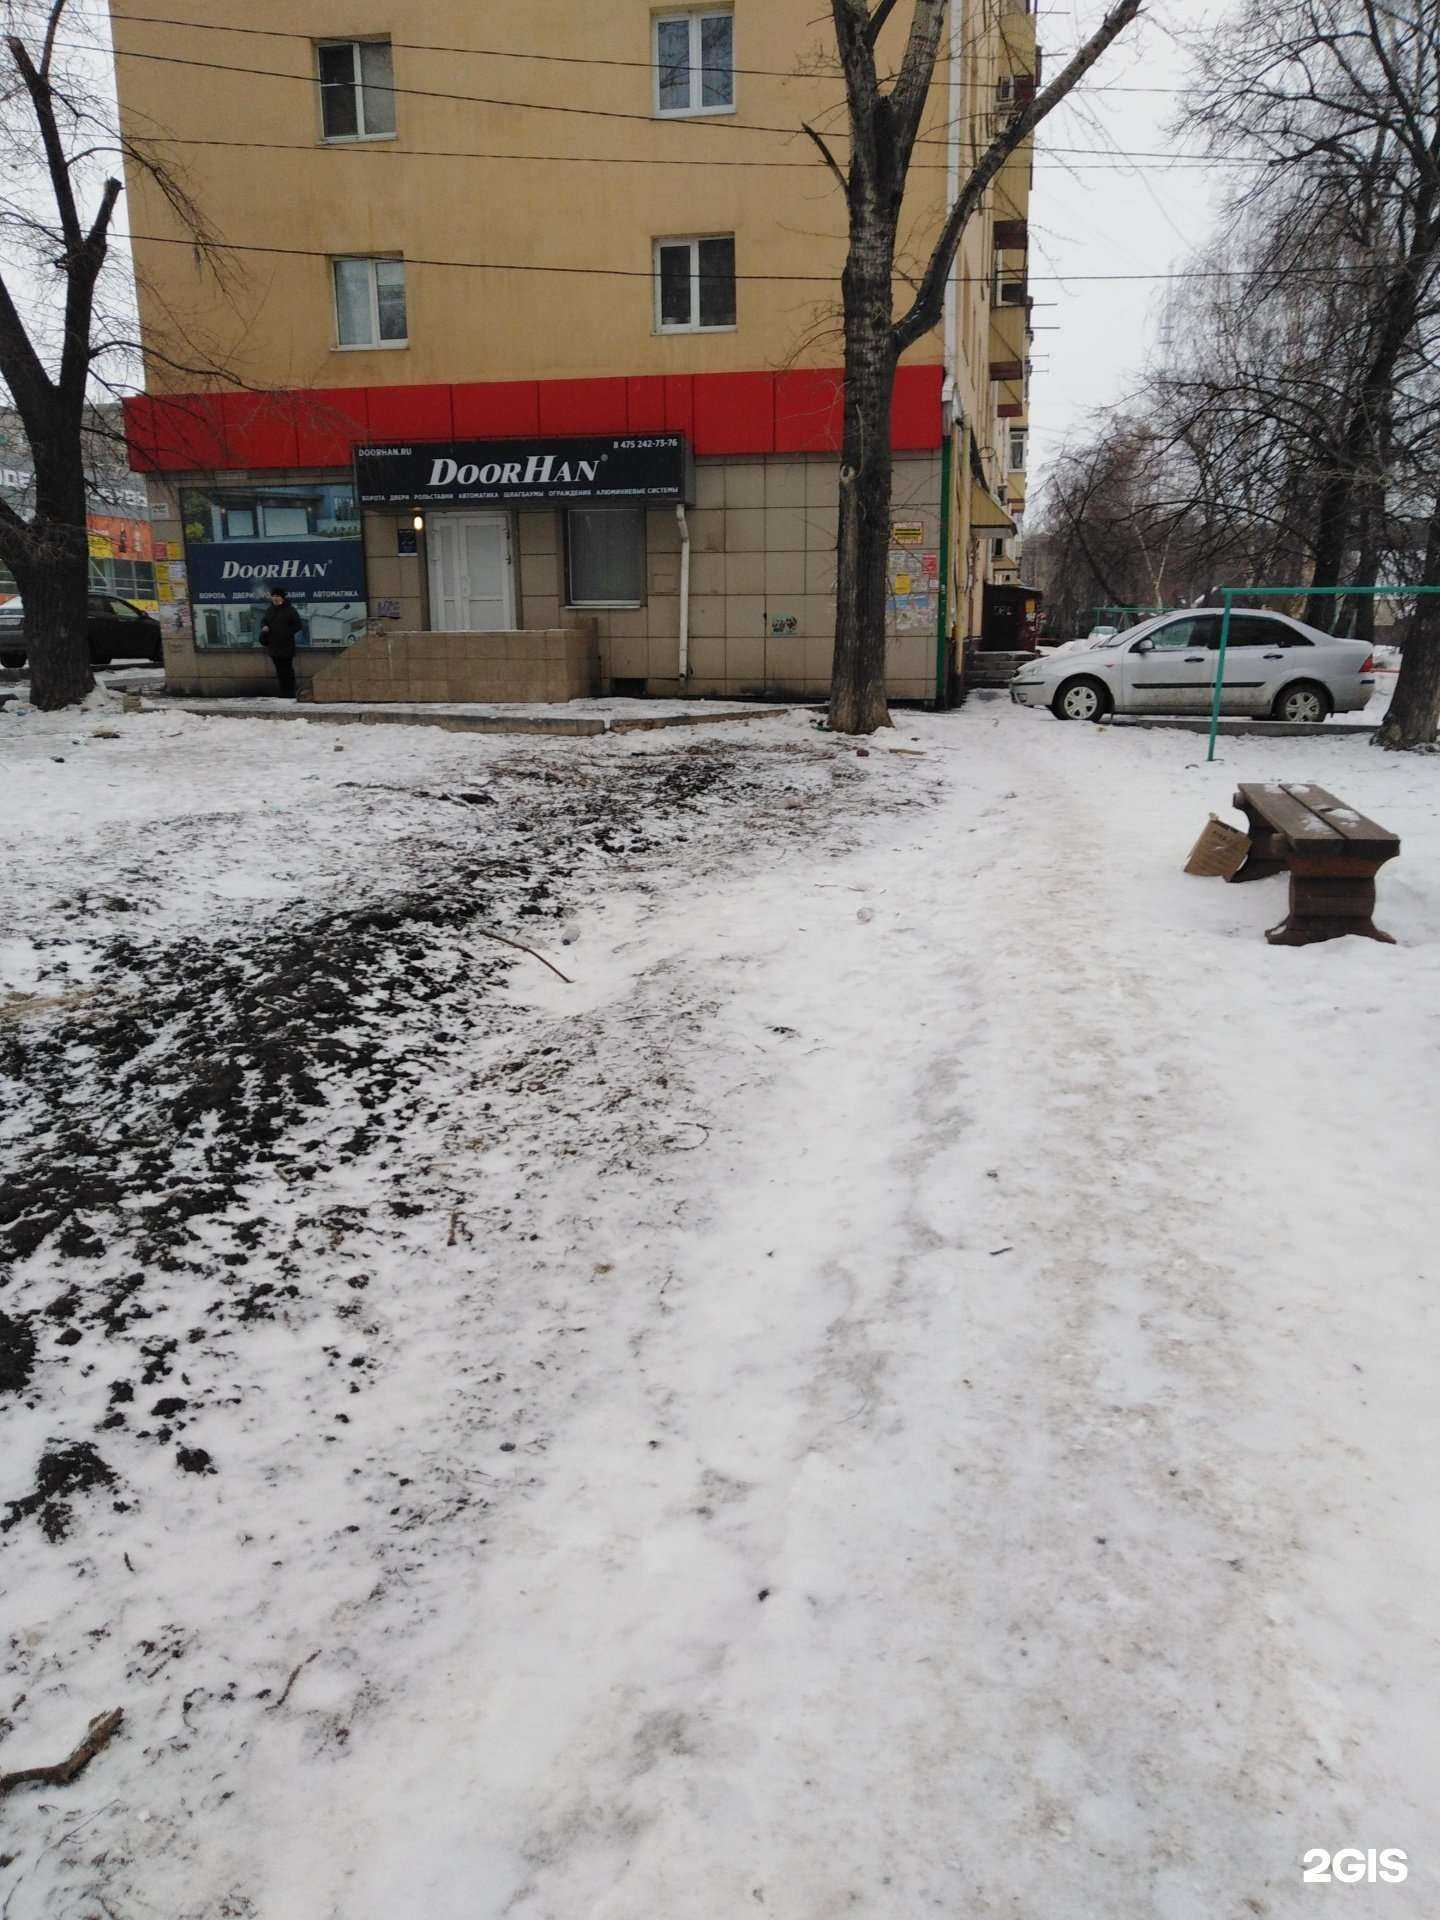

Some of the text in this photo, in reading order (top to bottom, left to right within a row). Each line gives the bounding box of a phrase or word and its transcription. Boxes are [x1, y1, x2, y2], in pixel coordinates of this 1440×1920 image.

[358, 447, 412, 457] DOORHAN.RU
[647, 486, 679, 494] СИСТЕМЫ
[312, 590, 359, 598] АВТОМАТИКА
